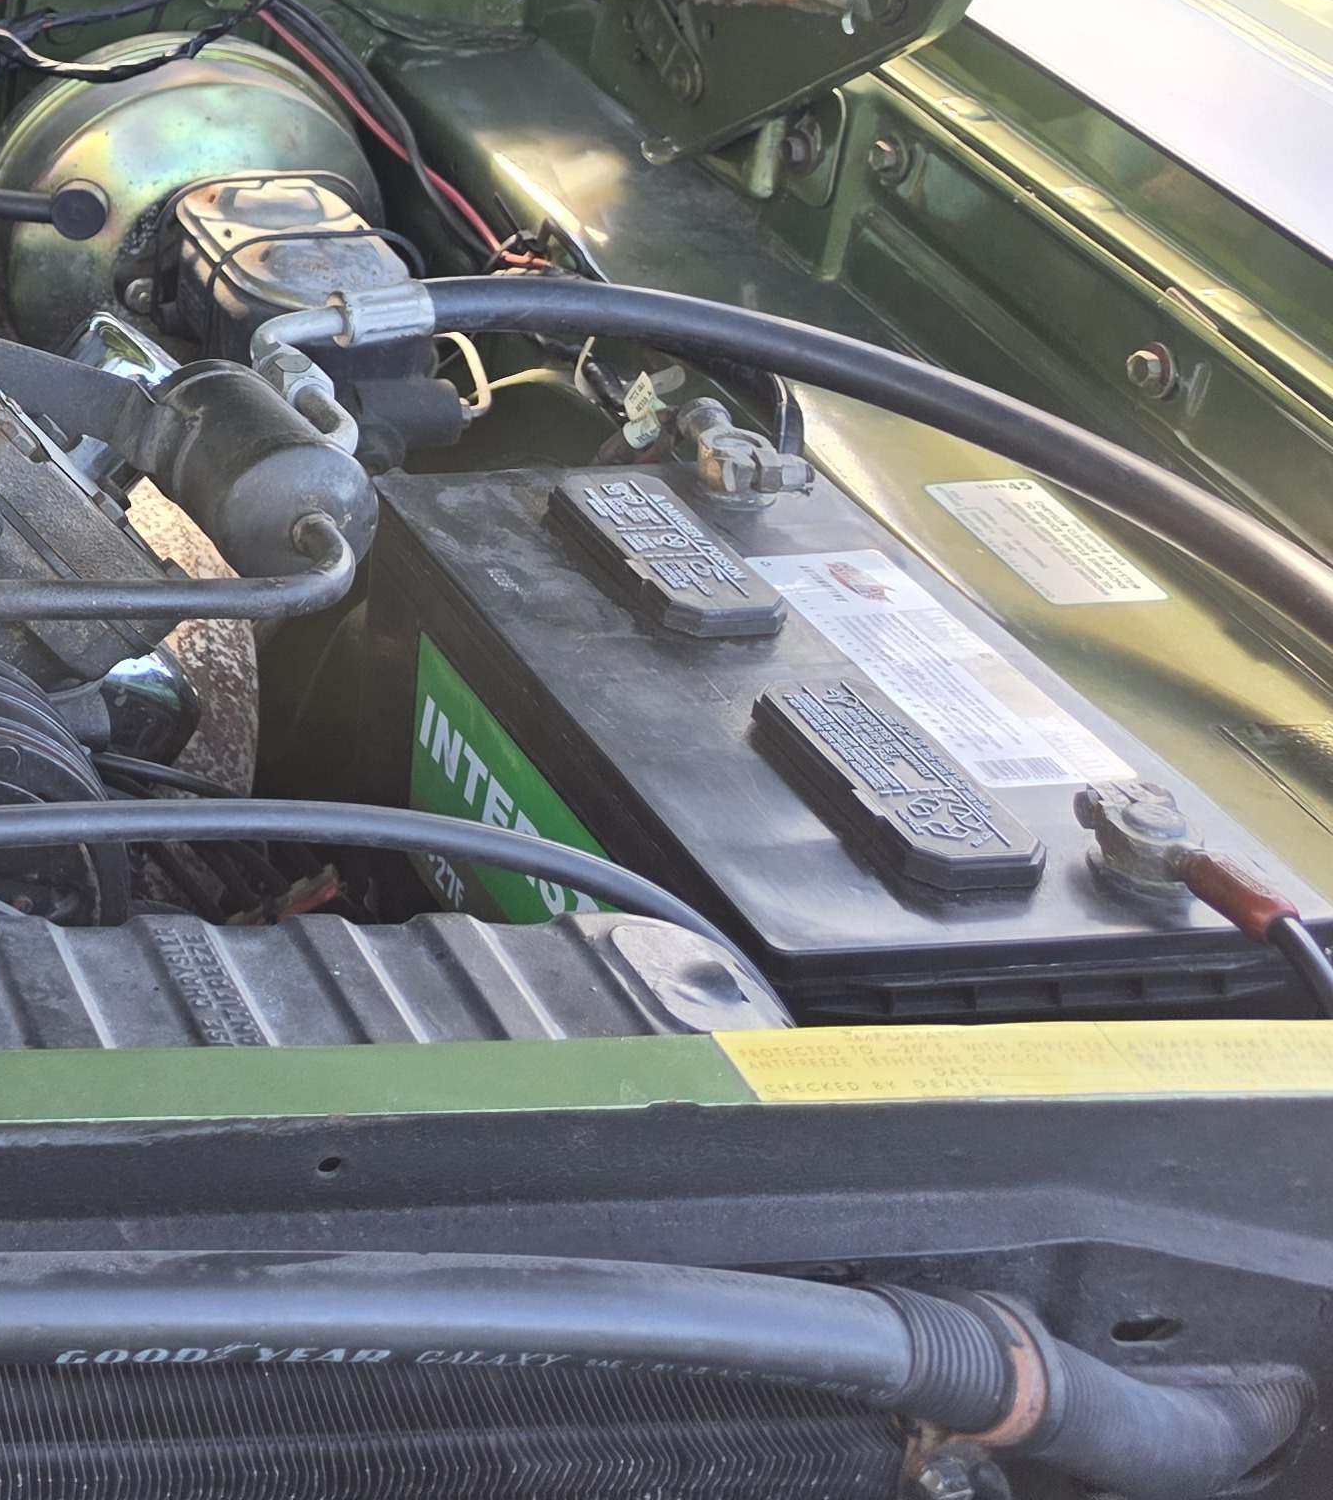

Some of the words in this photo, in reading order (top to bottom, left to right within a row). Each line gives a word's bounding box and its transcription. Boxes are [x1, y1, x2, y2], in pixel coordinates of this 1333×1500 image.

[181, 934, 266, 1046] ANTIFREEZE
[738, 1046, 841, 1059] PROTECTED
[850, 1045, 873, 1055] TO
[966, 1041, 1006, 1053] WITH
[748, 1056, 852, 1071] ANTIFREEZE
[972, 1052, 1052, 1066] GLYCOL
[932, 1066, 984, 1078] DATE
[765, 1080, 861, 1094] CHECKED
[874, 1078, 895, 1090] BY
[414, 1350, 572, 1368] GALAXY
[585, 1357, 624, 1370] SAE
